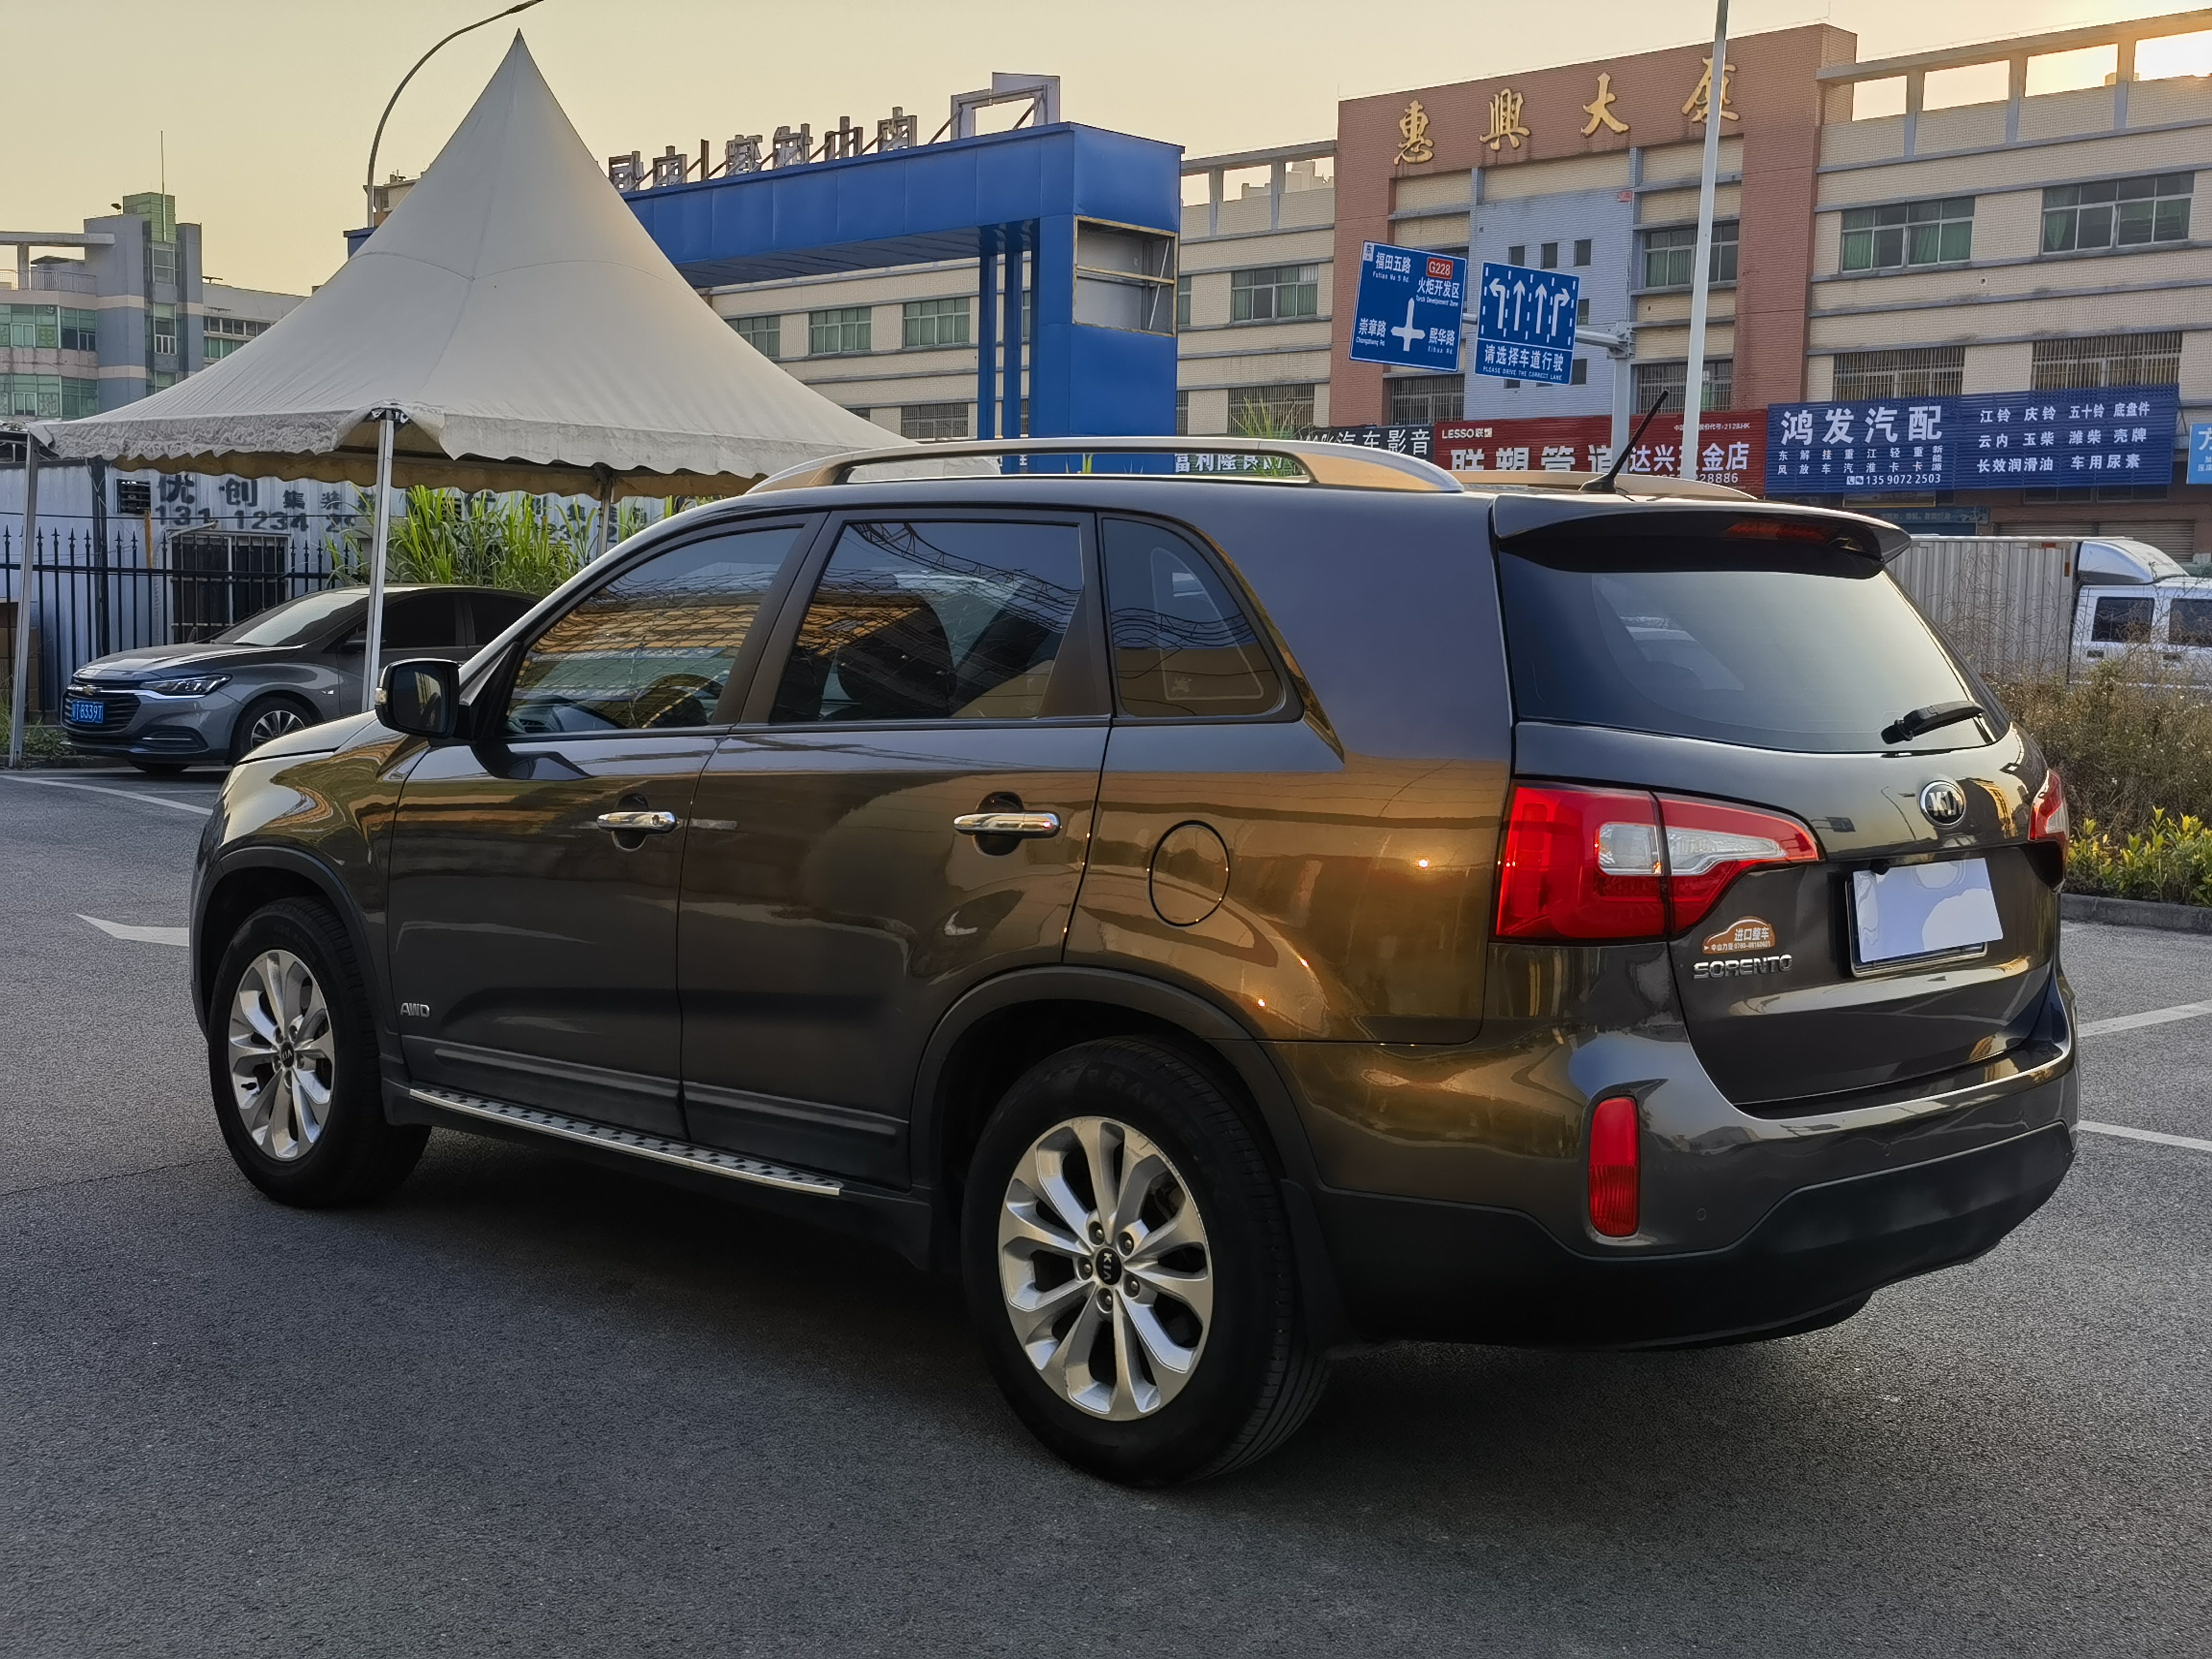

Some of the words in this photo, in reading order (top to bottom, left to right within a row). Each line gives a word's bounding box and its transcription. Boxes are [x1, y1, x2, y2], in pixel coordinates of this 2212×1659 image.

[1375, 252, 1411, 274] 福田五路
[1428, 261, 1451, 276] G228
[1417, 277, 1460, 299] 火炬开发区
[1358, 318, 1386, 338] 崇章路
[1428, 327, 1455, 347] 熙华路
[1485, 344, 1564, 372] 请选择车道行驶
[1483, 366, 1501, 374] PLEASE
[1528, 372, 1548, 380] CORRECT
[1980, 408, 2011, 423] 江铃
[2024, 406, 2056, 421] 庆铃
[2069, 403, 2105, 419] 五十铃
[2113, 401, 2150, 417] 底盘件
[1781, 406, 1943, 446] 鸿发汽配
[1978, 434, 2008, 448] 云内
[2023, 431, 2054, 446] 玉柴
[2069, 429, 2101, 444] 潍柴
[2114, 427, 2147, 443] 壳牌
[1629, 441, 1750, 472] 达兴金店
[1977, 457, 2053, 473] 长效润滑油
[2071, 454, 2140, 470] 车用尿素
[1866, 475, 1884, 485] 135
[1887, 474, 1912, 484] 9072
[1915, 473, 1941, 484] 2503
[234, 510, 309, 532] 1234
[1928, 791, 1963, 817] KIA
[1734, 927, 1770, 941] 进口整车
[1694, 954, 1792, 979] SORENTO
[400, 1002, 430, 1017] AWD
[1103, 1253, 1112, 1280] KIA
